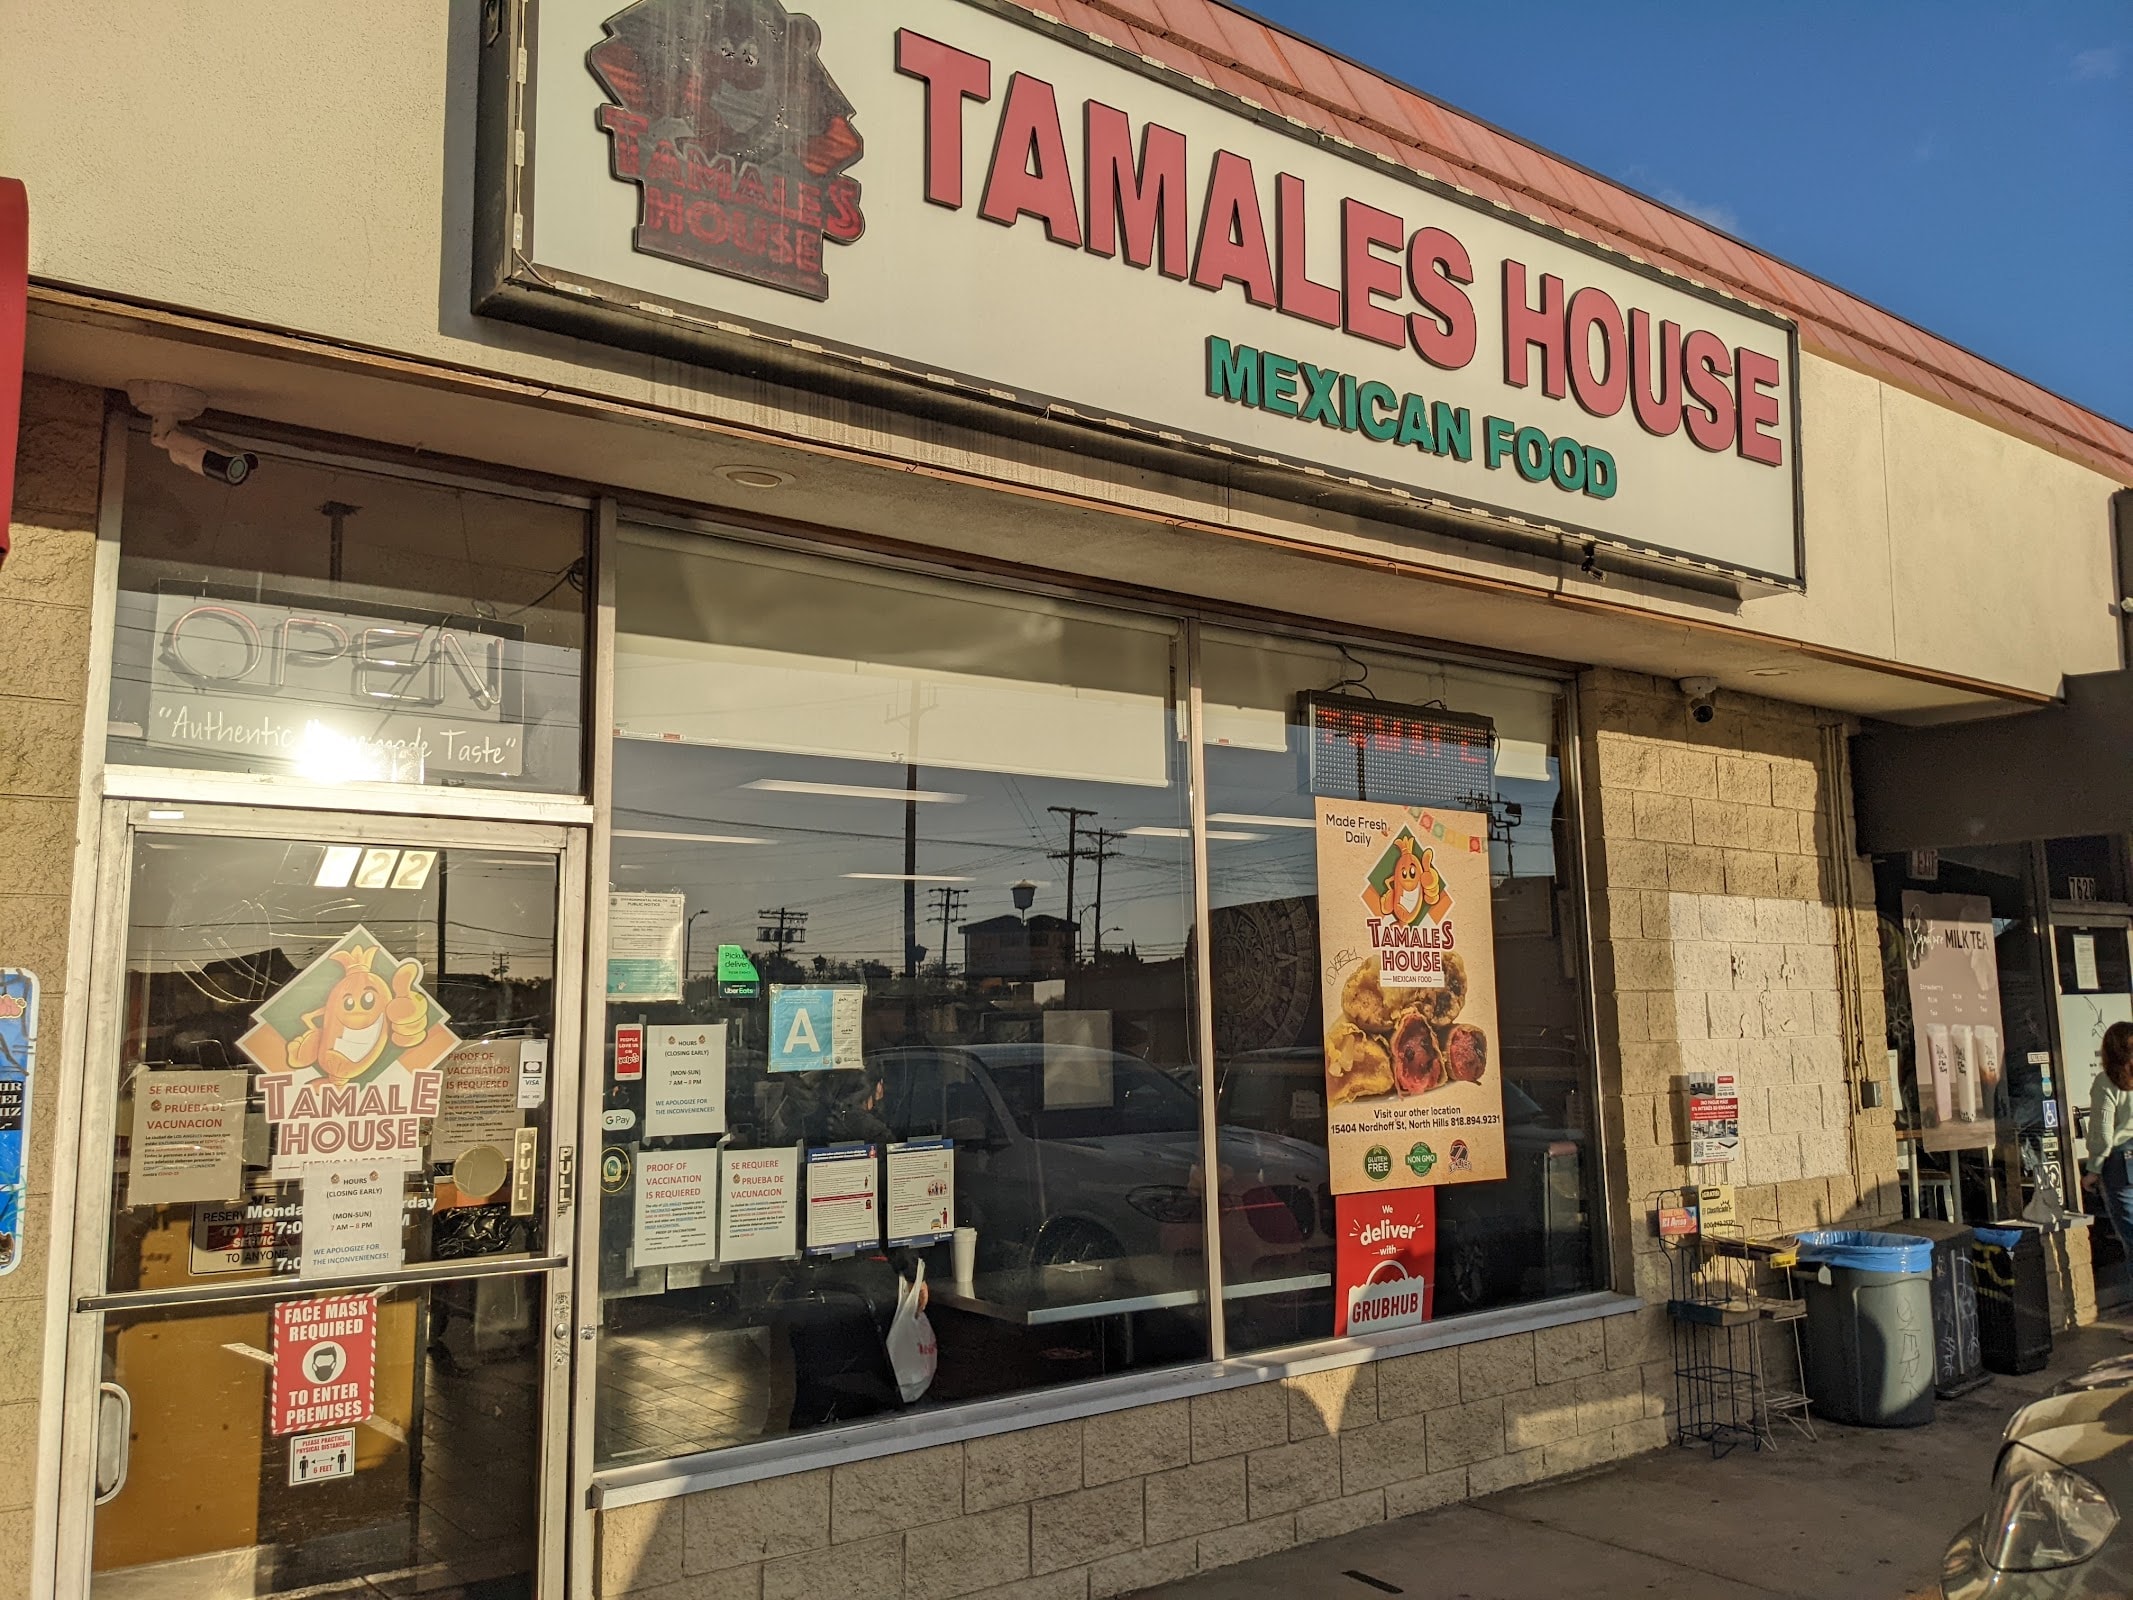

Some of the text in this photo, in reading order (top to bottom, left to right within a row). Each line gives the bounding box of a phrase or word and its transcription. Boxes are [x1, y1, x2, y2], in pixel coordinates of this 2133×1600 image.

[602, 106, 860, 238] TAMALES
[646, 186, 820, 272] HOUSE
[896, 28, 1783, 467] TAMALES HOUSE
[1206, 335, 1618, 500] MEXICAN FOOD
[171, 606, 505, 704] OPEN
[1326, 813, 1387, 830] Made Fresh
[1345, 831, 1372, 847] Daily
[1366, 918, 1455, 950] TAMALES
[1944, 928, 1969, 950] MILK
[1970, 930, 1989, 950] TEA
[724, 960, 750, 970] delivery
[1382, 950, 1441, 972] HOUSE
[782, 1007, 821, 1054] A
[664, 1050, 690, 1058] (CLOSING
[446, 1066, 511, 1075] VACCINATION
[149, 1084, 220, 1095] SE REQUIERE
[446, 1081, 455, 1090] IS
[256, 1071, 443, 1121] TAMALE
[164, 1102, 210, 1114] PRUEBA
[1374, 1104, 1461, 1119] Visit our other location
[146, 1118, 223, 1130] VACUNACION
[616, 1116, 630, 1126] Pay
[1330, 1114, 1500, 1134] 15404 Nordhoff St, North Hills 818.894.9231
[280, 1117, 418, 1156] HOUSE
[731, 1160, 779, 1170] SE REQUIERE
[1407, 1154, 1436, 1164] NON GMO
[518, 1142, 532, 1201] PULL
[646, 1162, 688, 1172] PROOF OF
[1368, 1162, 1388, 1172] FREE
[558, 1148, 573, 1202] PULL
[646, 1174, 702, 1186] VACCINATION
[742, 1174, 784, 1186] PRUEBA DE
[326, 1188, 383, 1198] (CLOSING EARLY)
[646, 1188, 701, 1200] IS REQUIERED
[731, 1188, 782, 1199] VACUNACION
[332, 1210, 372, 1220] (MON-SUN)
[1382, 1205, 1394, 1214] We
[1360, 1218, 1417, 1246] deliver
[226, 1248, 289, 1264] TO ANYONE
[326, 1244, 364, 1254] APOLOGIZE
[1380, 1244, 1396, 1256] with
[284, 1300, 368, 1324] FACE MASK
[1352, 1292, 1418, 1324] GRUBHUB
[289, 1318, 364, 1342] REQUIRED
[288, 1382, 358, 1407] TO ENTER
[286, 1400, 362, 1426] PREMISES
[296, 1440, 351, 1454] PHYSICAL DISTANCING
[302, 1435, 345, 1447] PLEASE PRACTICE
[320, 1464, 332, 1472] FEET
